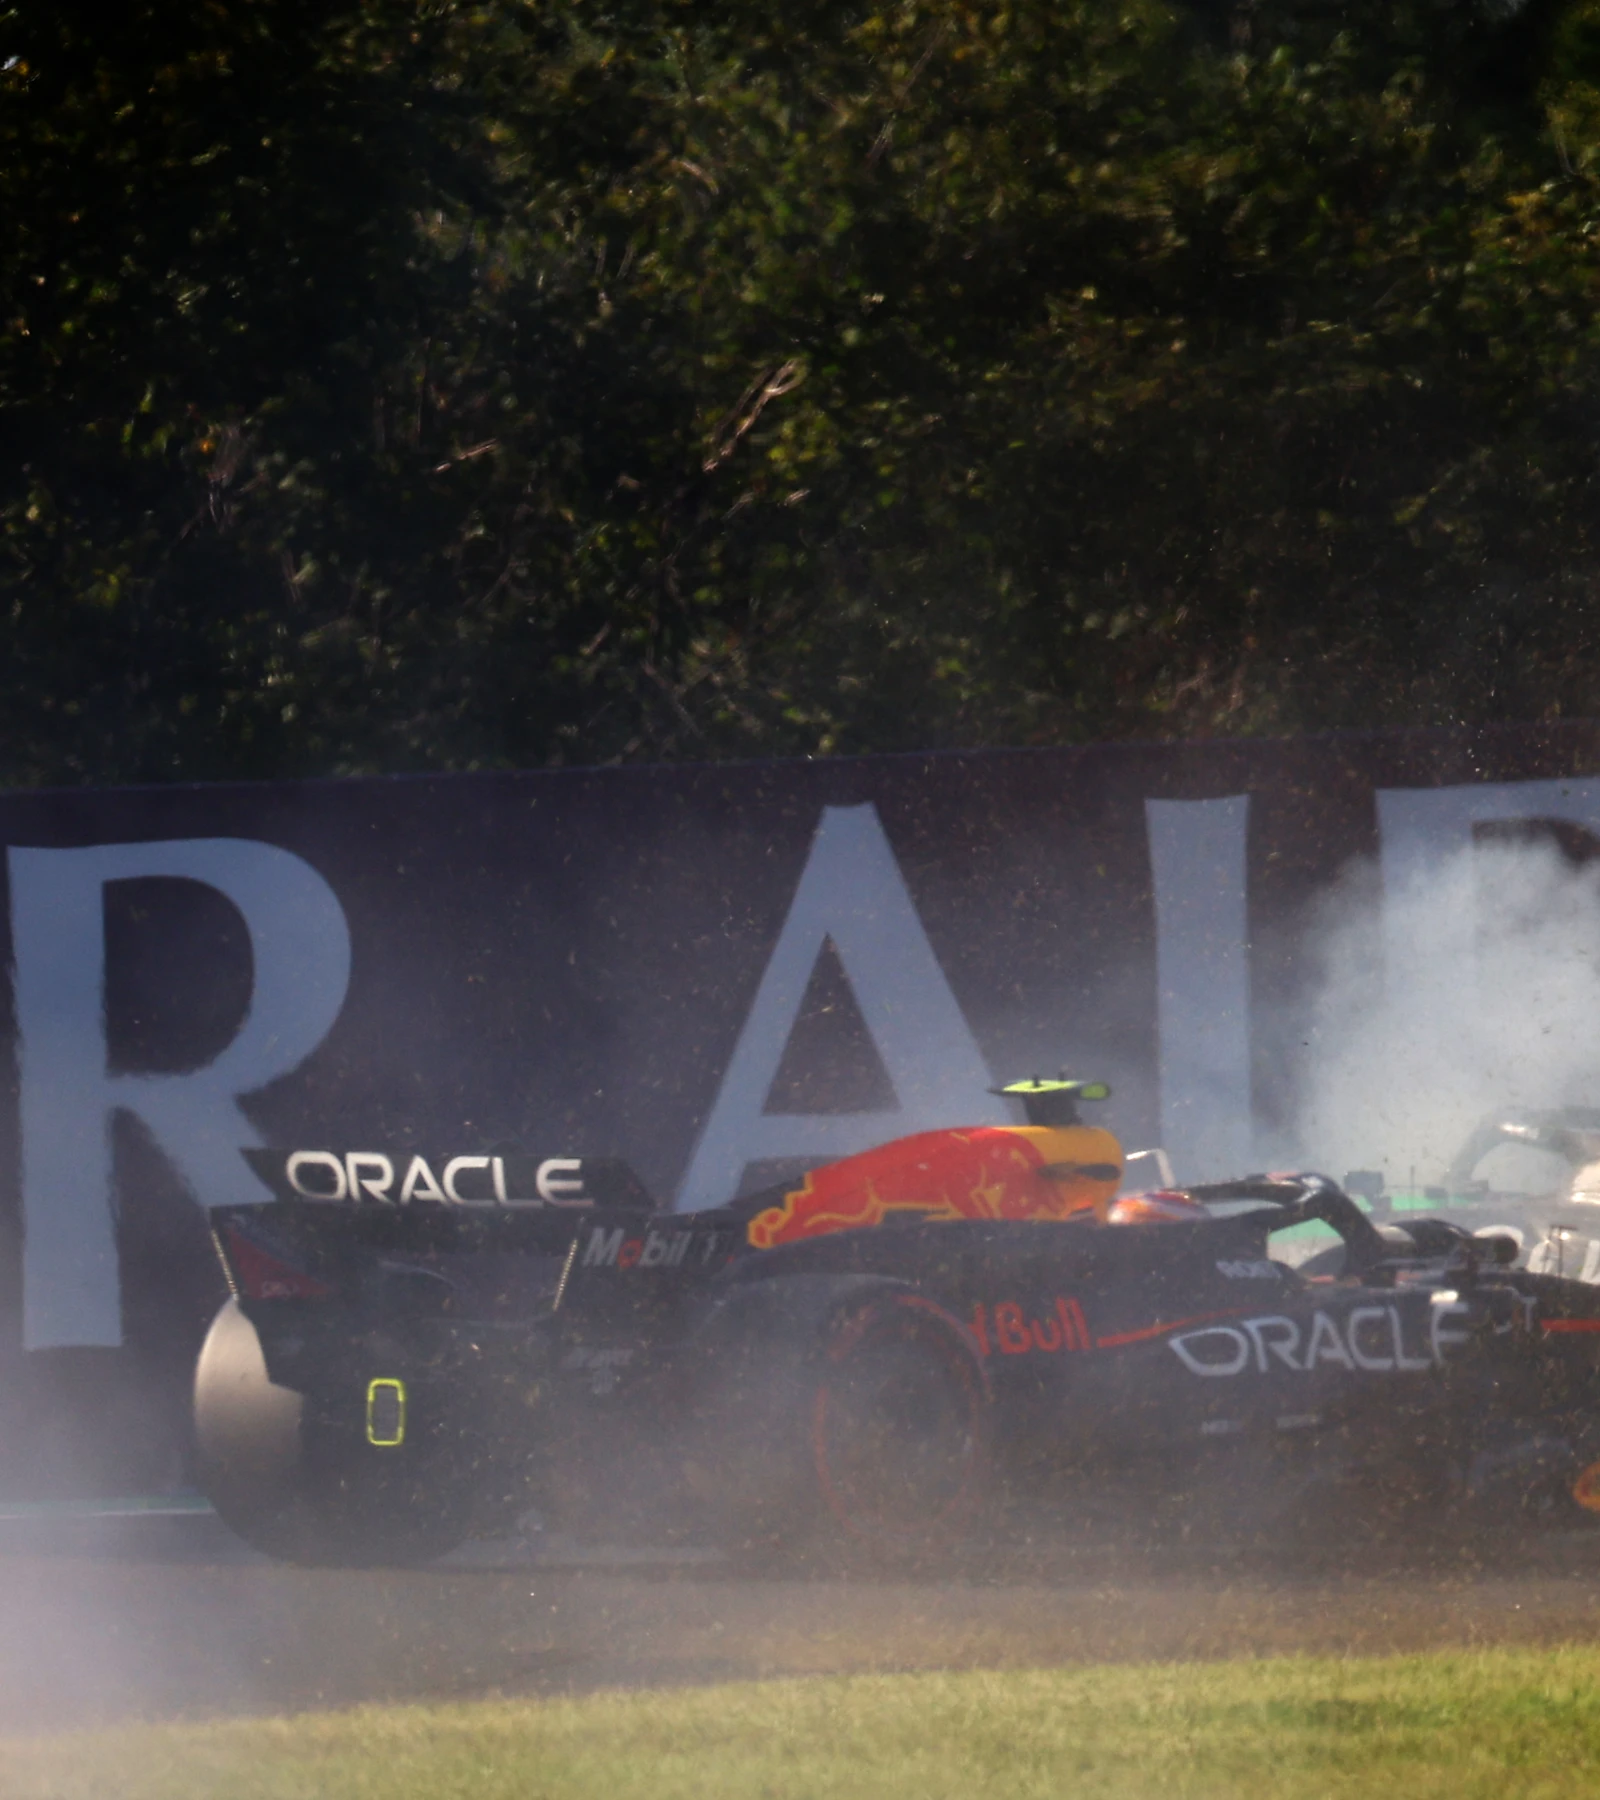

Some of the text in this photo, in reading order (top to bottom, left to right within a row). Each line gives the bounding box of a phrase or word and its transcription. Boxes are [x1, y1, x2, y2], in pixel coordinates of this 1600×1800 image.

[7, 837, 352, 1350] R
[286, 1150, 594, 1207] ORACLE
[577, 1227, 693, 1269] Mobil
[994, 1297, 1091, 1355] Bull
